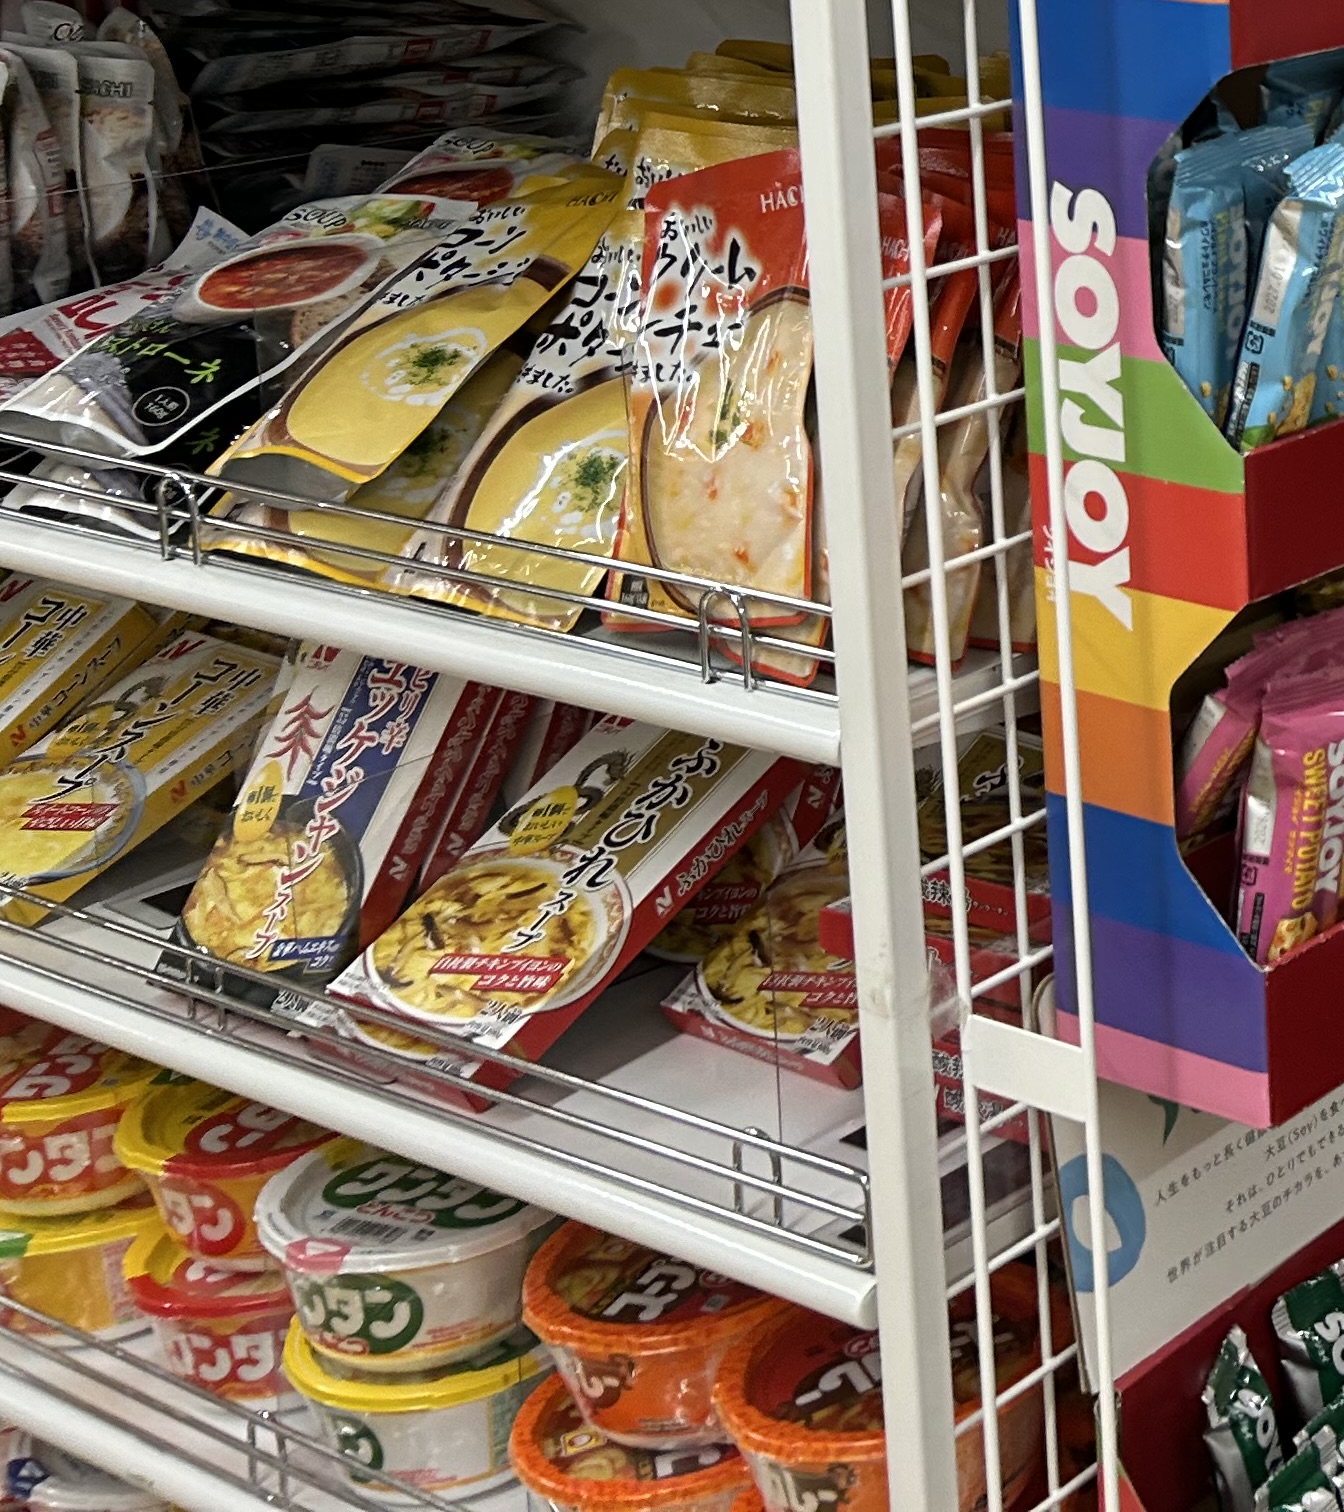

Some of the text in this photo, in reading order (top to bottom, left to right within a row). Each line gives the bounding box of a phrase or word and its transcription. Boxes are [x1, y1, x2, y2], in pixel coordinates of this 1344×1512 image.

[439, 225, 527, 258] コーン
[1050, 180, 1134, 631] SOYJOY
[29, 658, 237, 804] コーンスープ
[196, 667, 262, 716] 中華
[676, 790, 769, 895] ふかひれスープ
[1290, 746, 1326, 911] SWEET POTATO
[478, 972, 555, 990] コクと旨味
